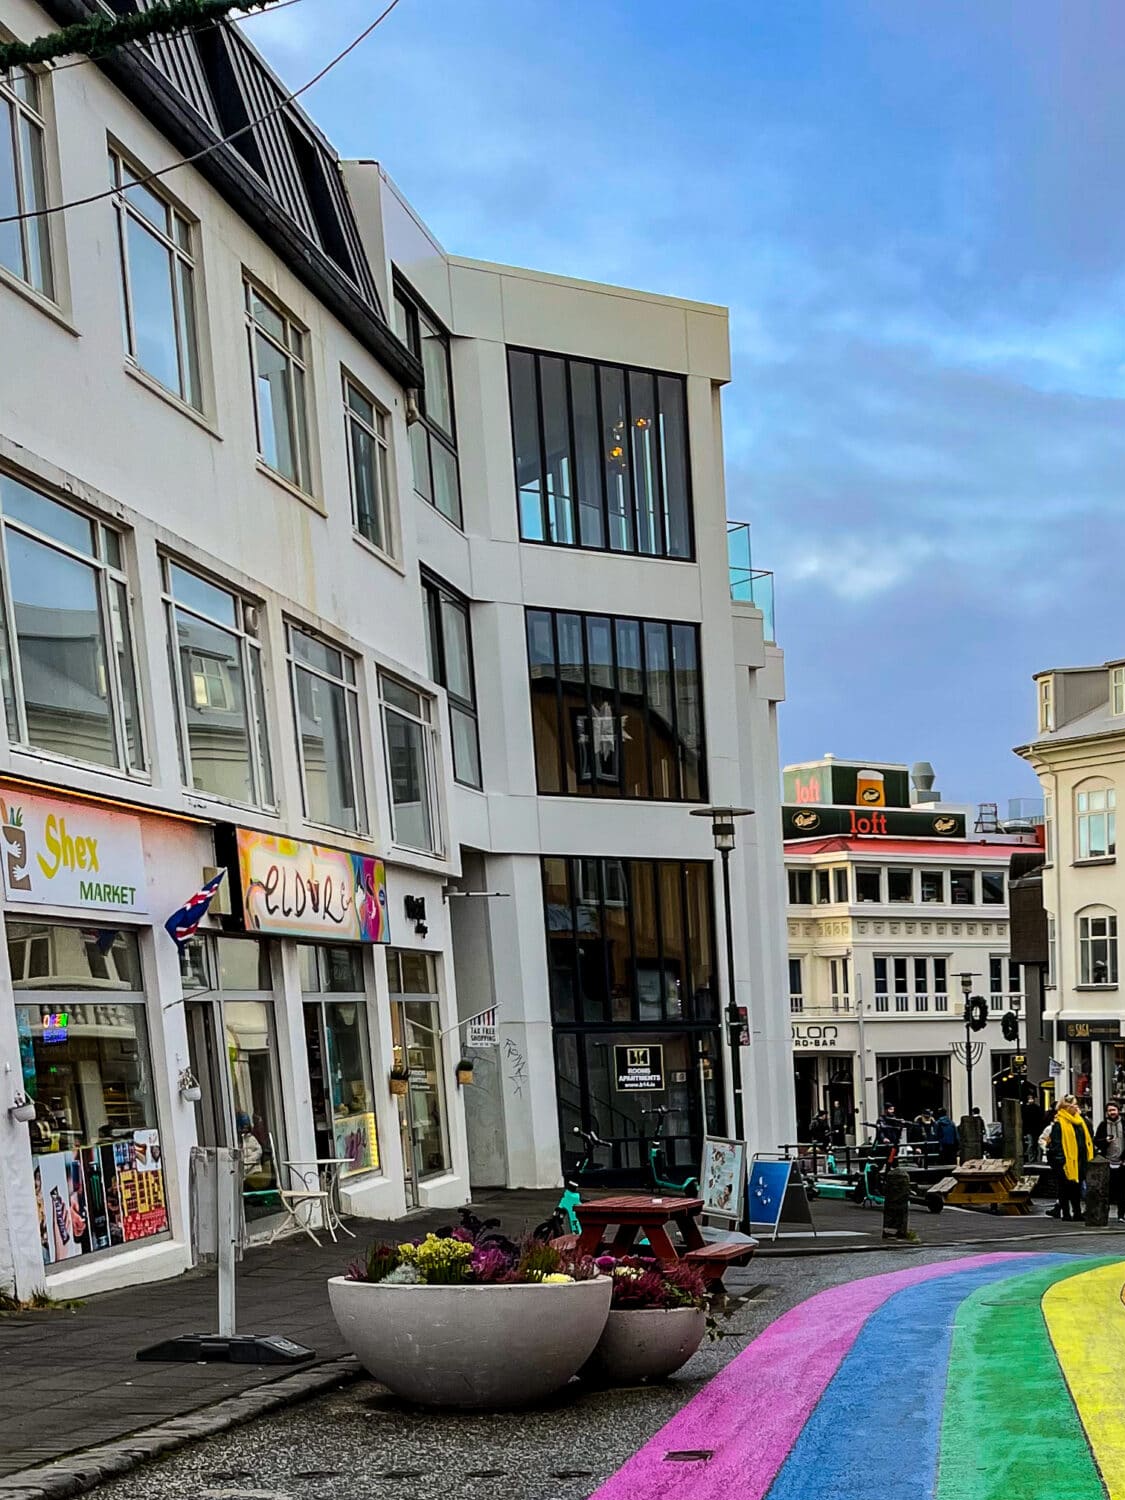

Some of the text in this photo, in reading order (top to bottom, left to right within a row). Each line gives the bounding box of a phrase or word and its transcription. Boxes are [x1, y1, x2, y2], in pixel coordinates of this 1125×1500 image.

[796, 776, 820, 804] loft
[849, 809, 887, 834] loft
[36, 813, 100, 880] Shex
[80, 880, 136, 906] MARKET
[482, 1027, 495, 1035] FREE
[792, 1026, 838, 1039] LON
[618, 1074, 661, 1082] APARTMENTS
